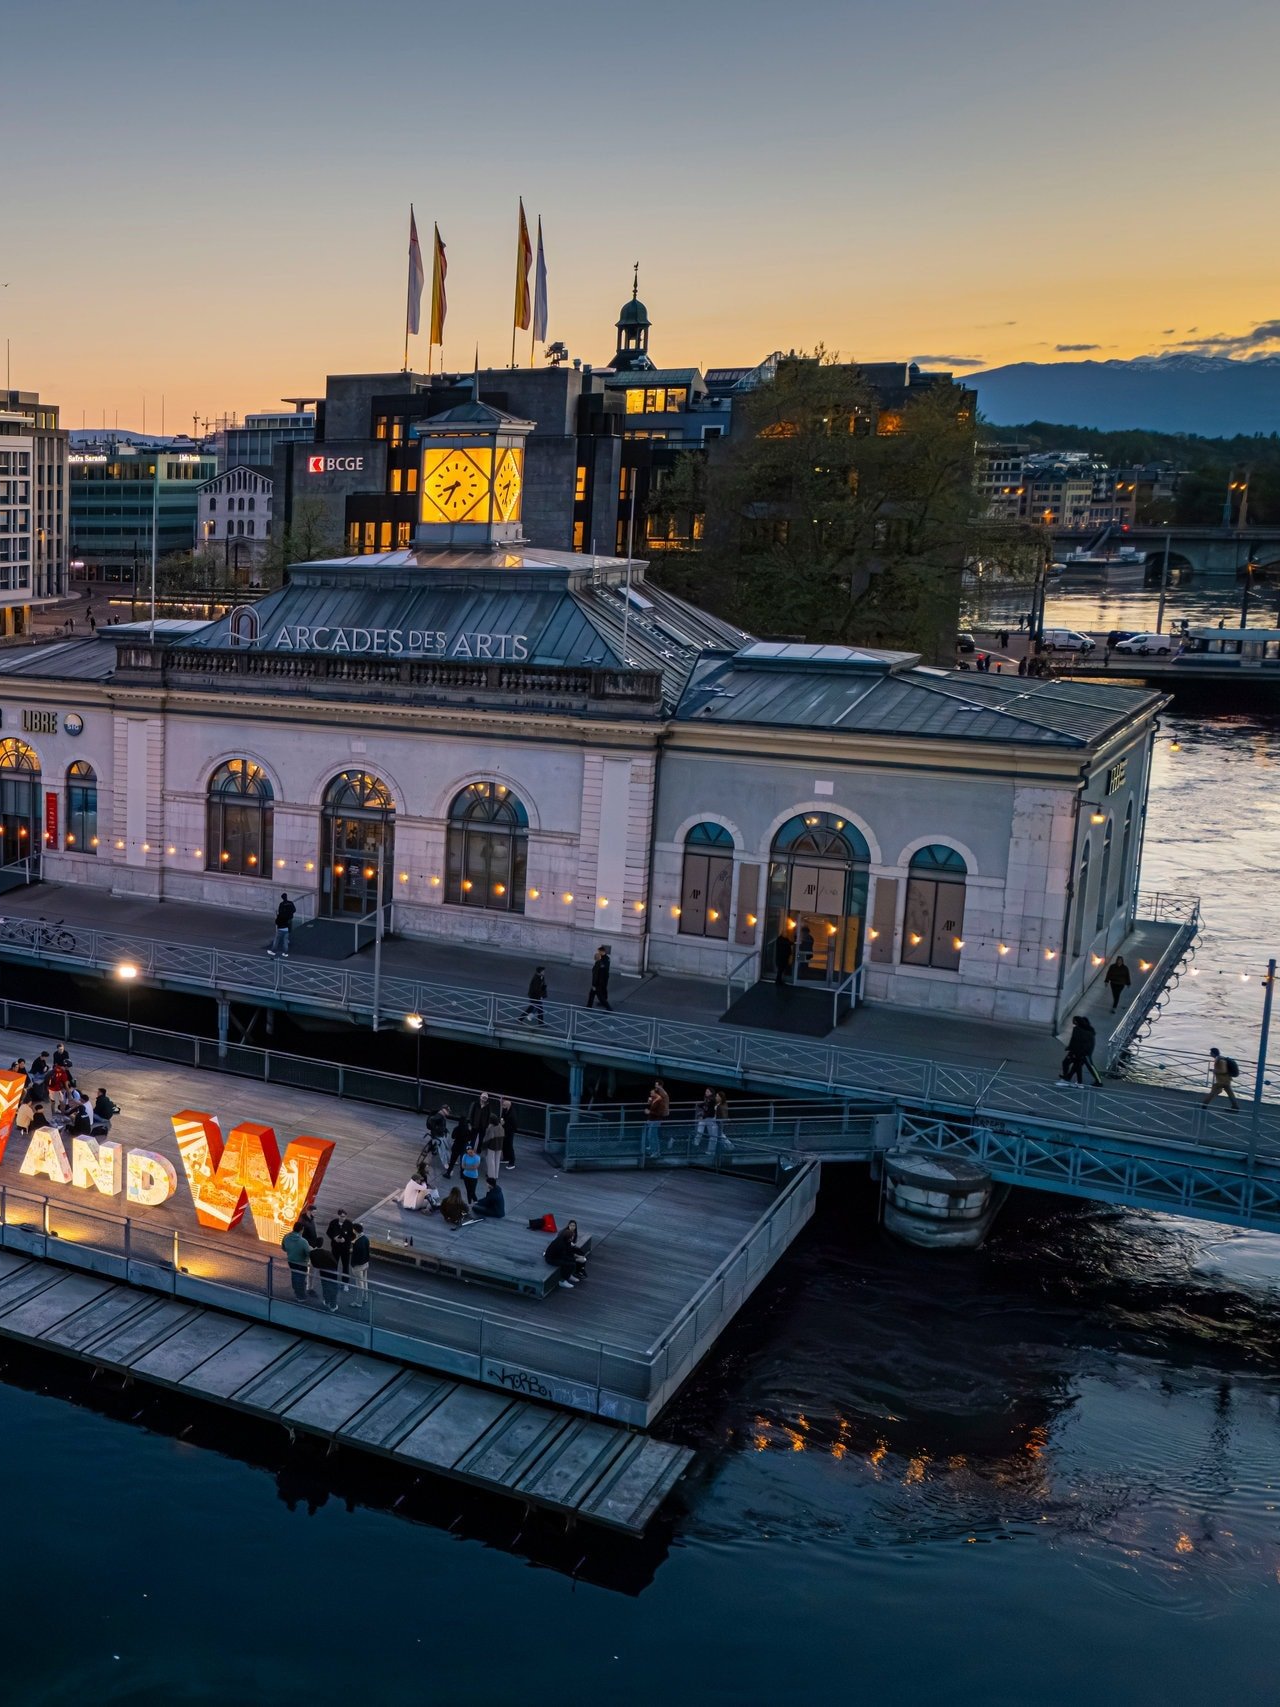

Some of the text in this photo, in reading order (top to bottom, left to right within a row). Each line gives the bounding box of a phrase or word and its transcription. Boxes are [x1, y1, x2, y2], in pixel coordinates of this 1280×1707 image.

[68, 454, 84, 462] Safra
[327, 457, 363, 471] BCGE
[275, 624, 528, 660] ARCADES DES ARTS
[22, 709, 57, 734] LIBRE
[19, 1126, 177, 1206] AND
[172, 1110, 336, 1245] W
